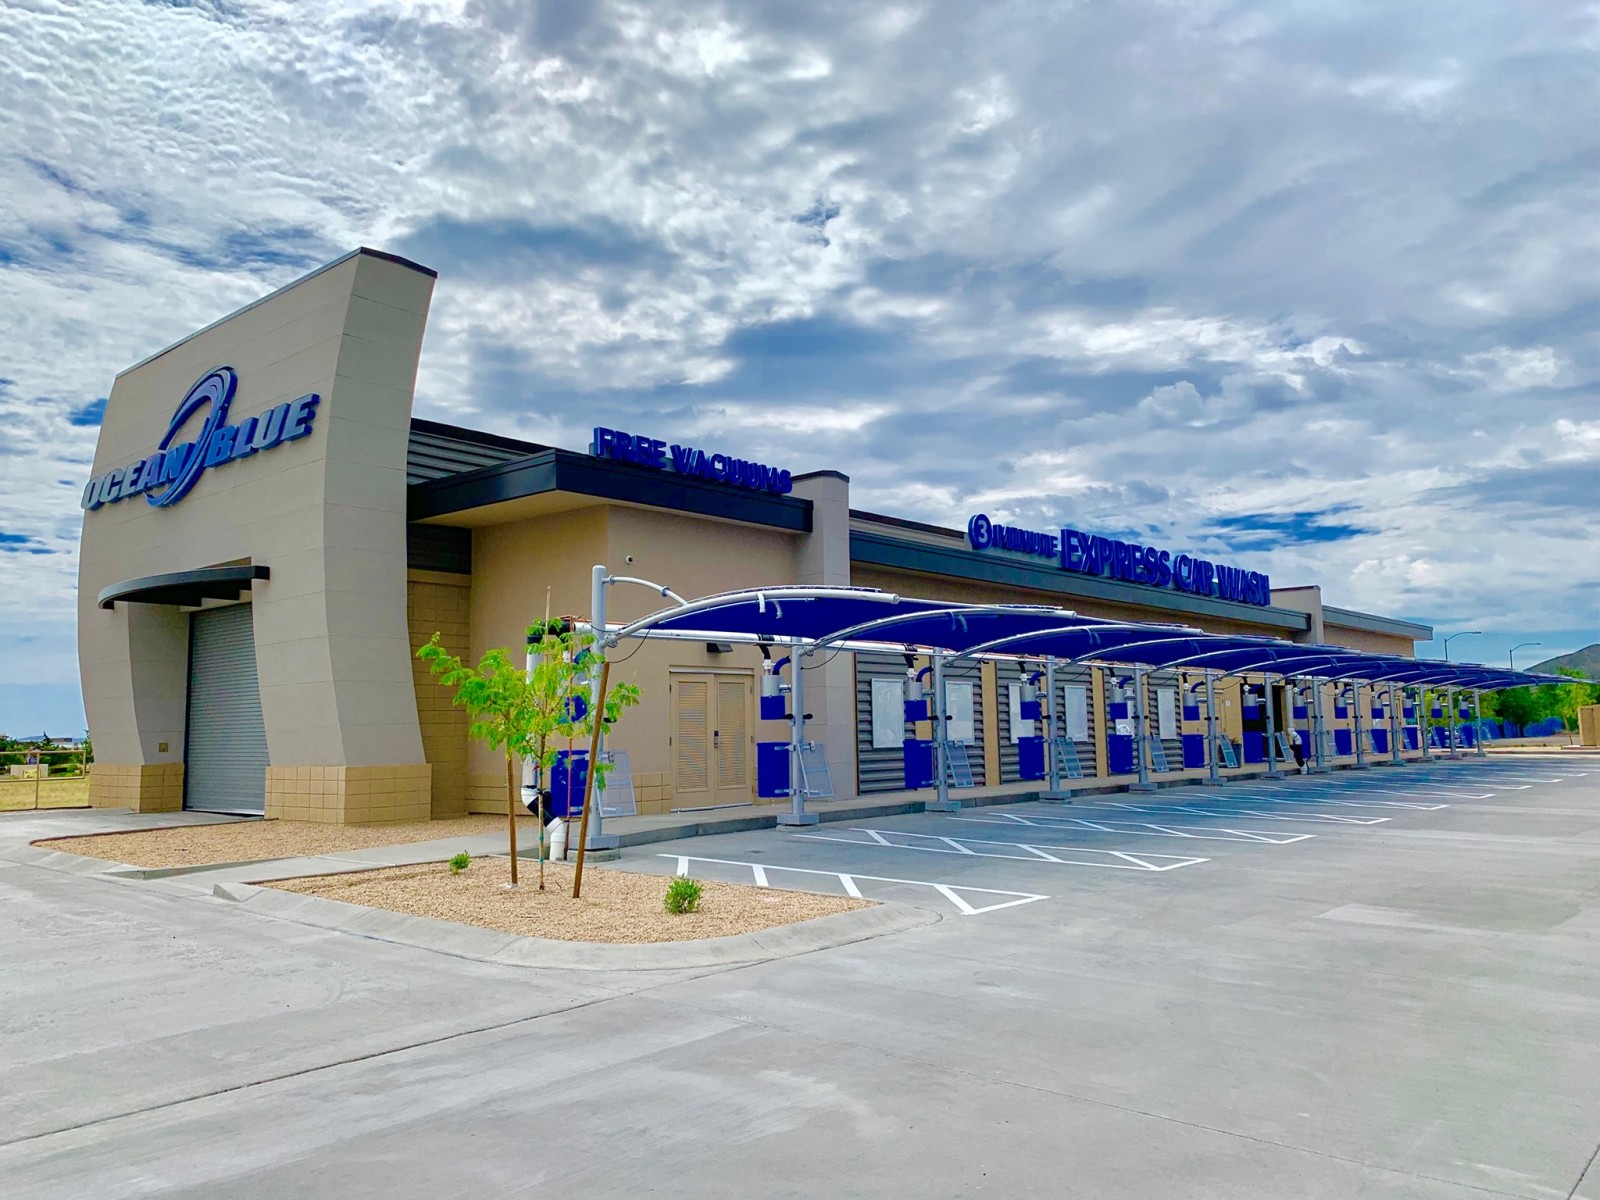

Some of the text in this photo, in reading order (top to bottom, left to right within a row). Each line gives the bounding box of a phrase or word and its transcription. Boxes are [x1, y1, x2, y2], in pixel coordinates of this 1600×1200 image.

[81, 393, 320, 510] OCEAN BLUE
[594, 427, 792, 494] FREE VACUUMS
[993, 524, 1058, 558] MINUTE
[1061, 528, 1172, 586] EXPRESS
[1173, 555, 1214, 596] CAR
[1216, 565, 1270, 606] WASH
